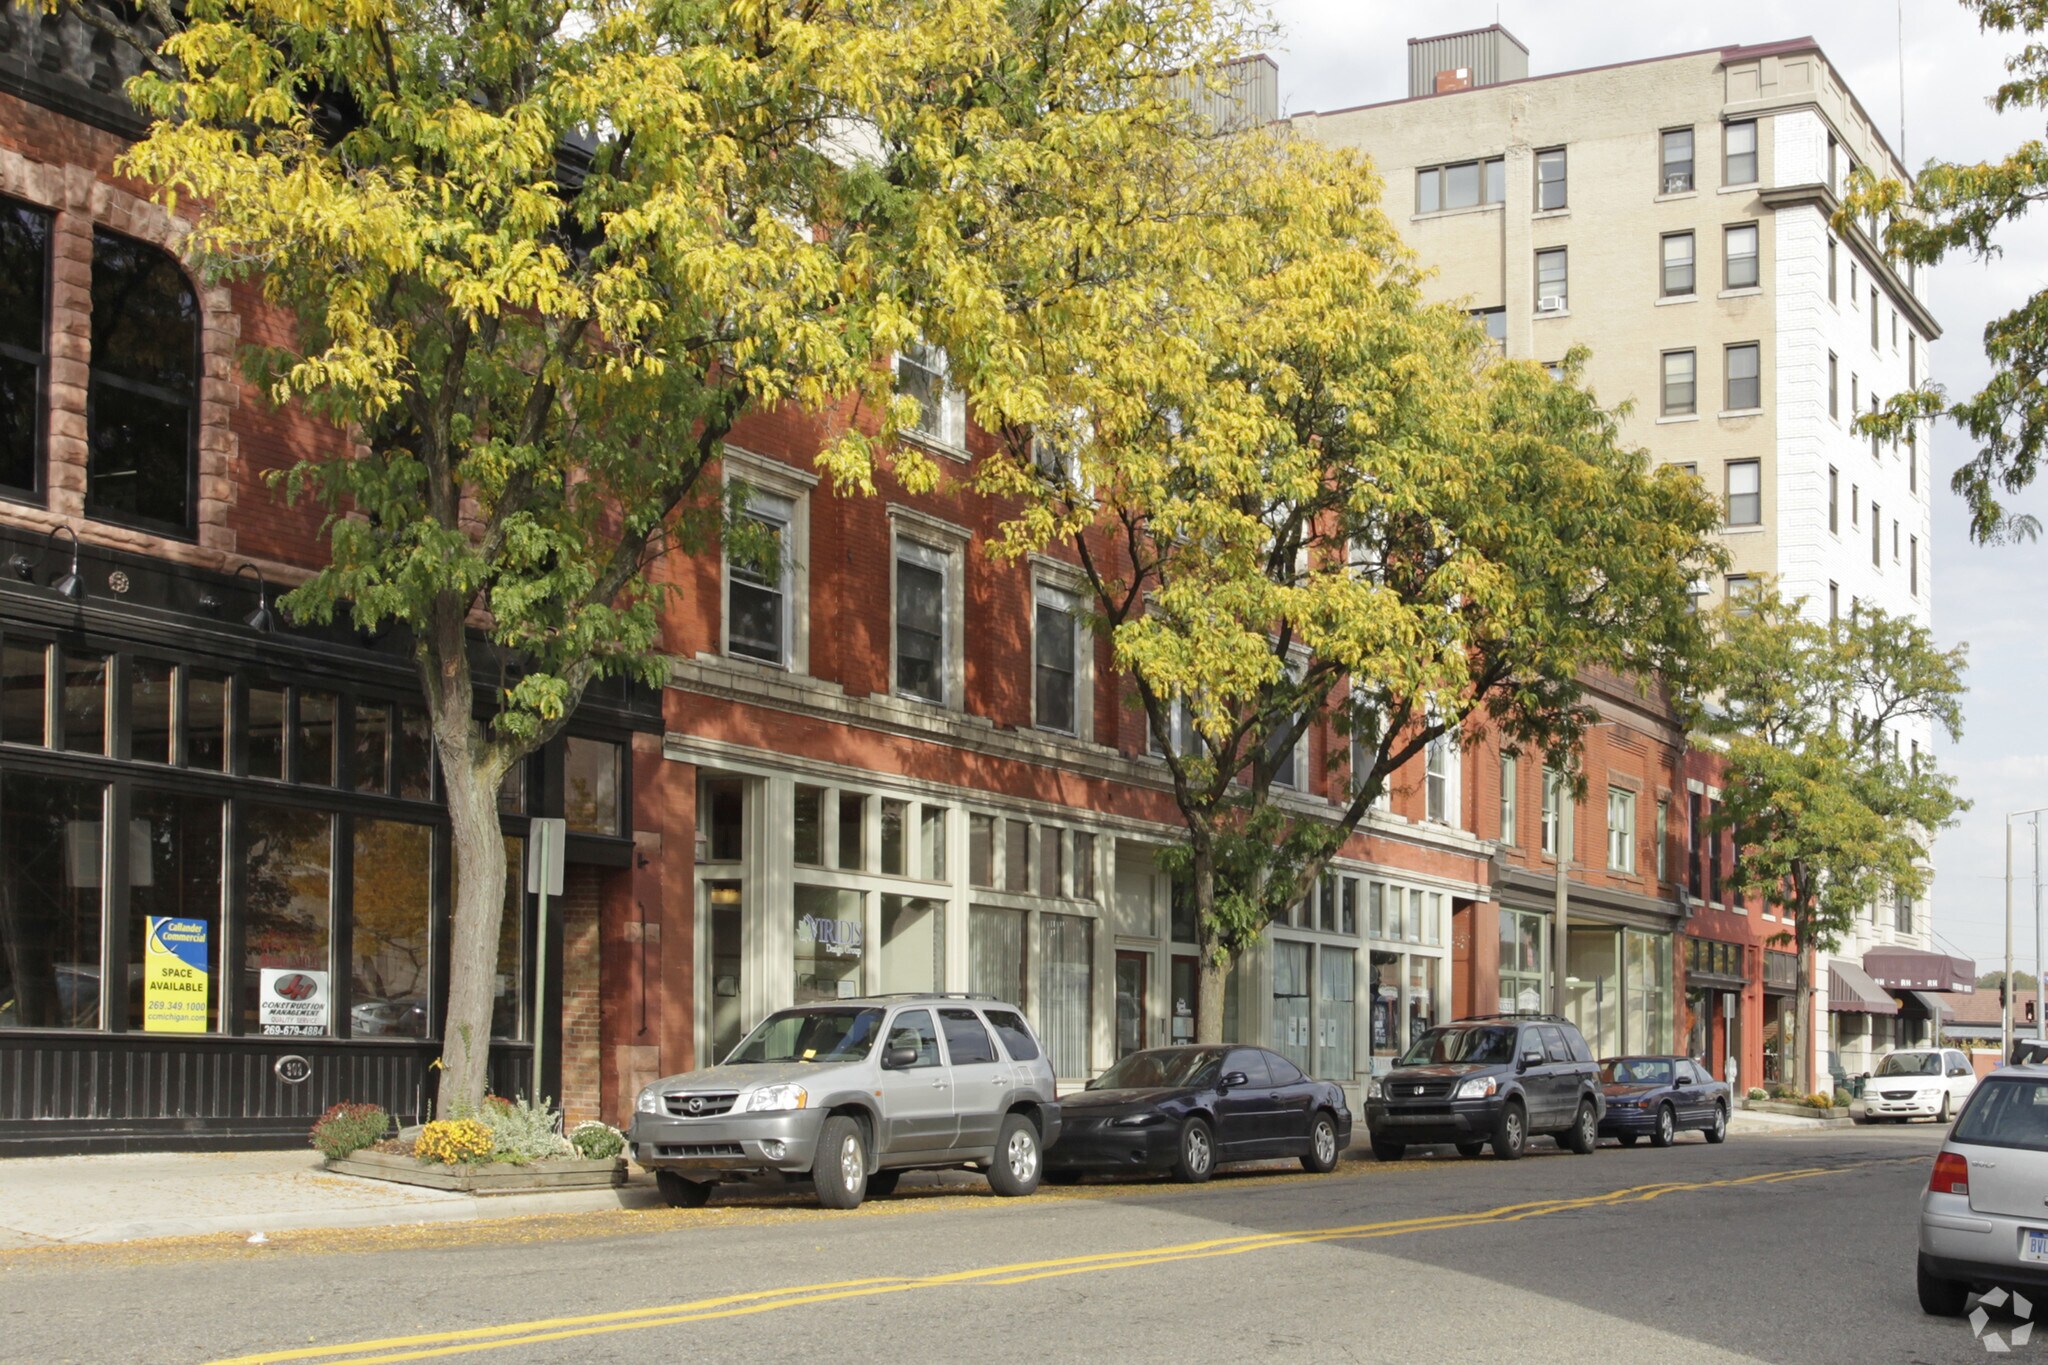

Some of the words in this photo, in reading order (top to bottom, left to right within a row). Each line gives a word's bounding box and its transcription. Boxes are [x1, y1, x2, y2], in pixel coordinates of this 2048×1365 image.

[168, 922, 203, 933] Callander
[803, 913, 862, 945] VIRIDIS
[163, 932, 206, 943] Commercial
[826, 944, 844, 956] Design
[845, 945, 862, 957] Group
[162, 968, 193, 978] SPACE
[150, 981, 203, 992] AVAILABLE
[1900, 979, 1911, 987] RH
[1927, 979, 1938, 987] RH
[148, 1001, 206, 1011] 269.349.1000
[262, 1001, 325, 1011] CONSTRUCTION
[148, 1013, 206, 1023] ccmichigan.com
[263, 1025, 324, 1036] 269-679-4884
